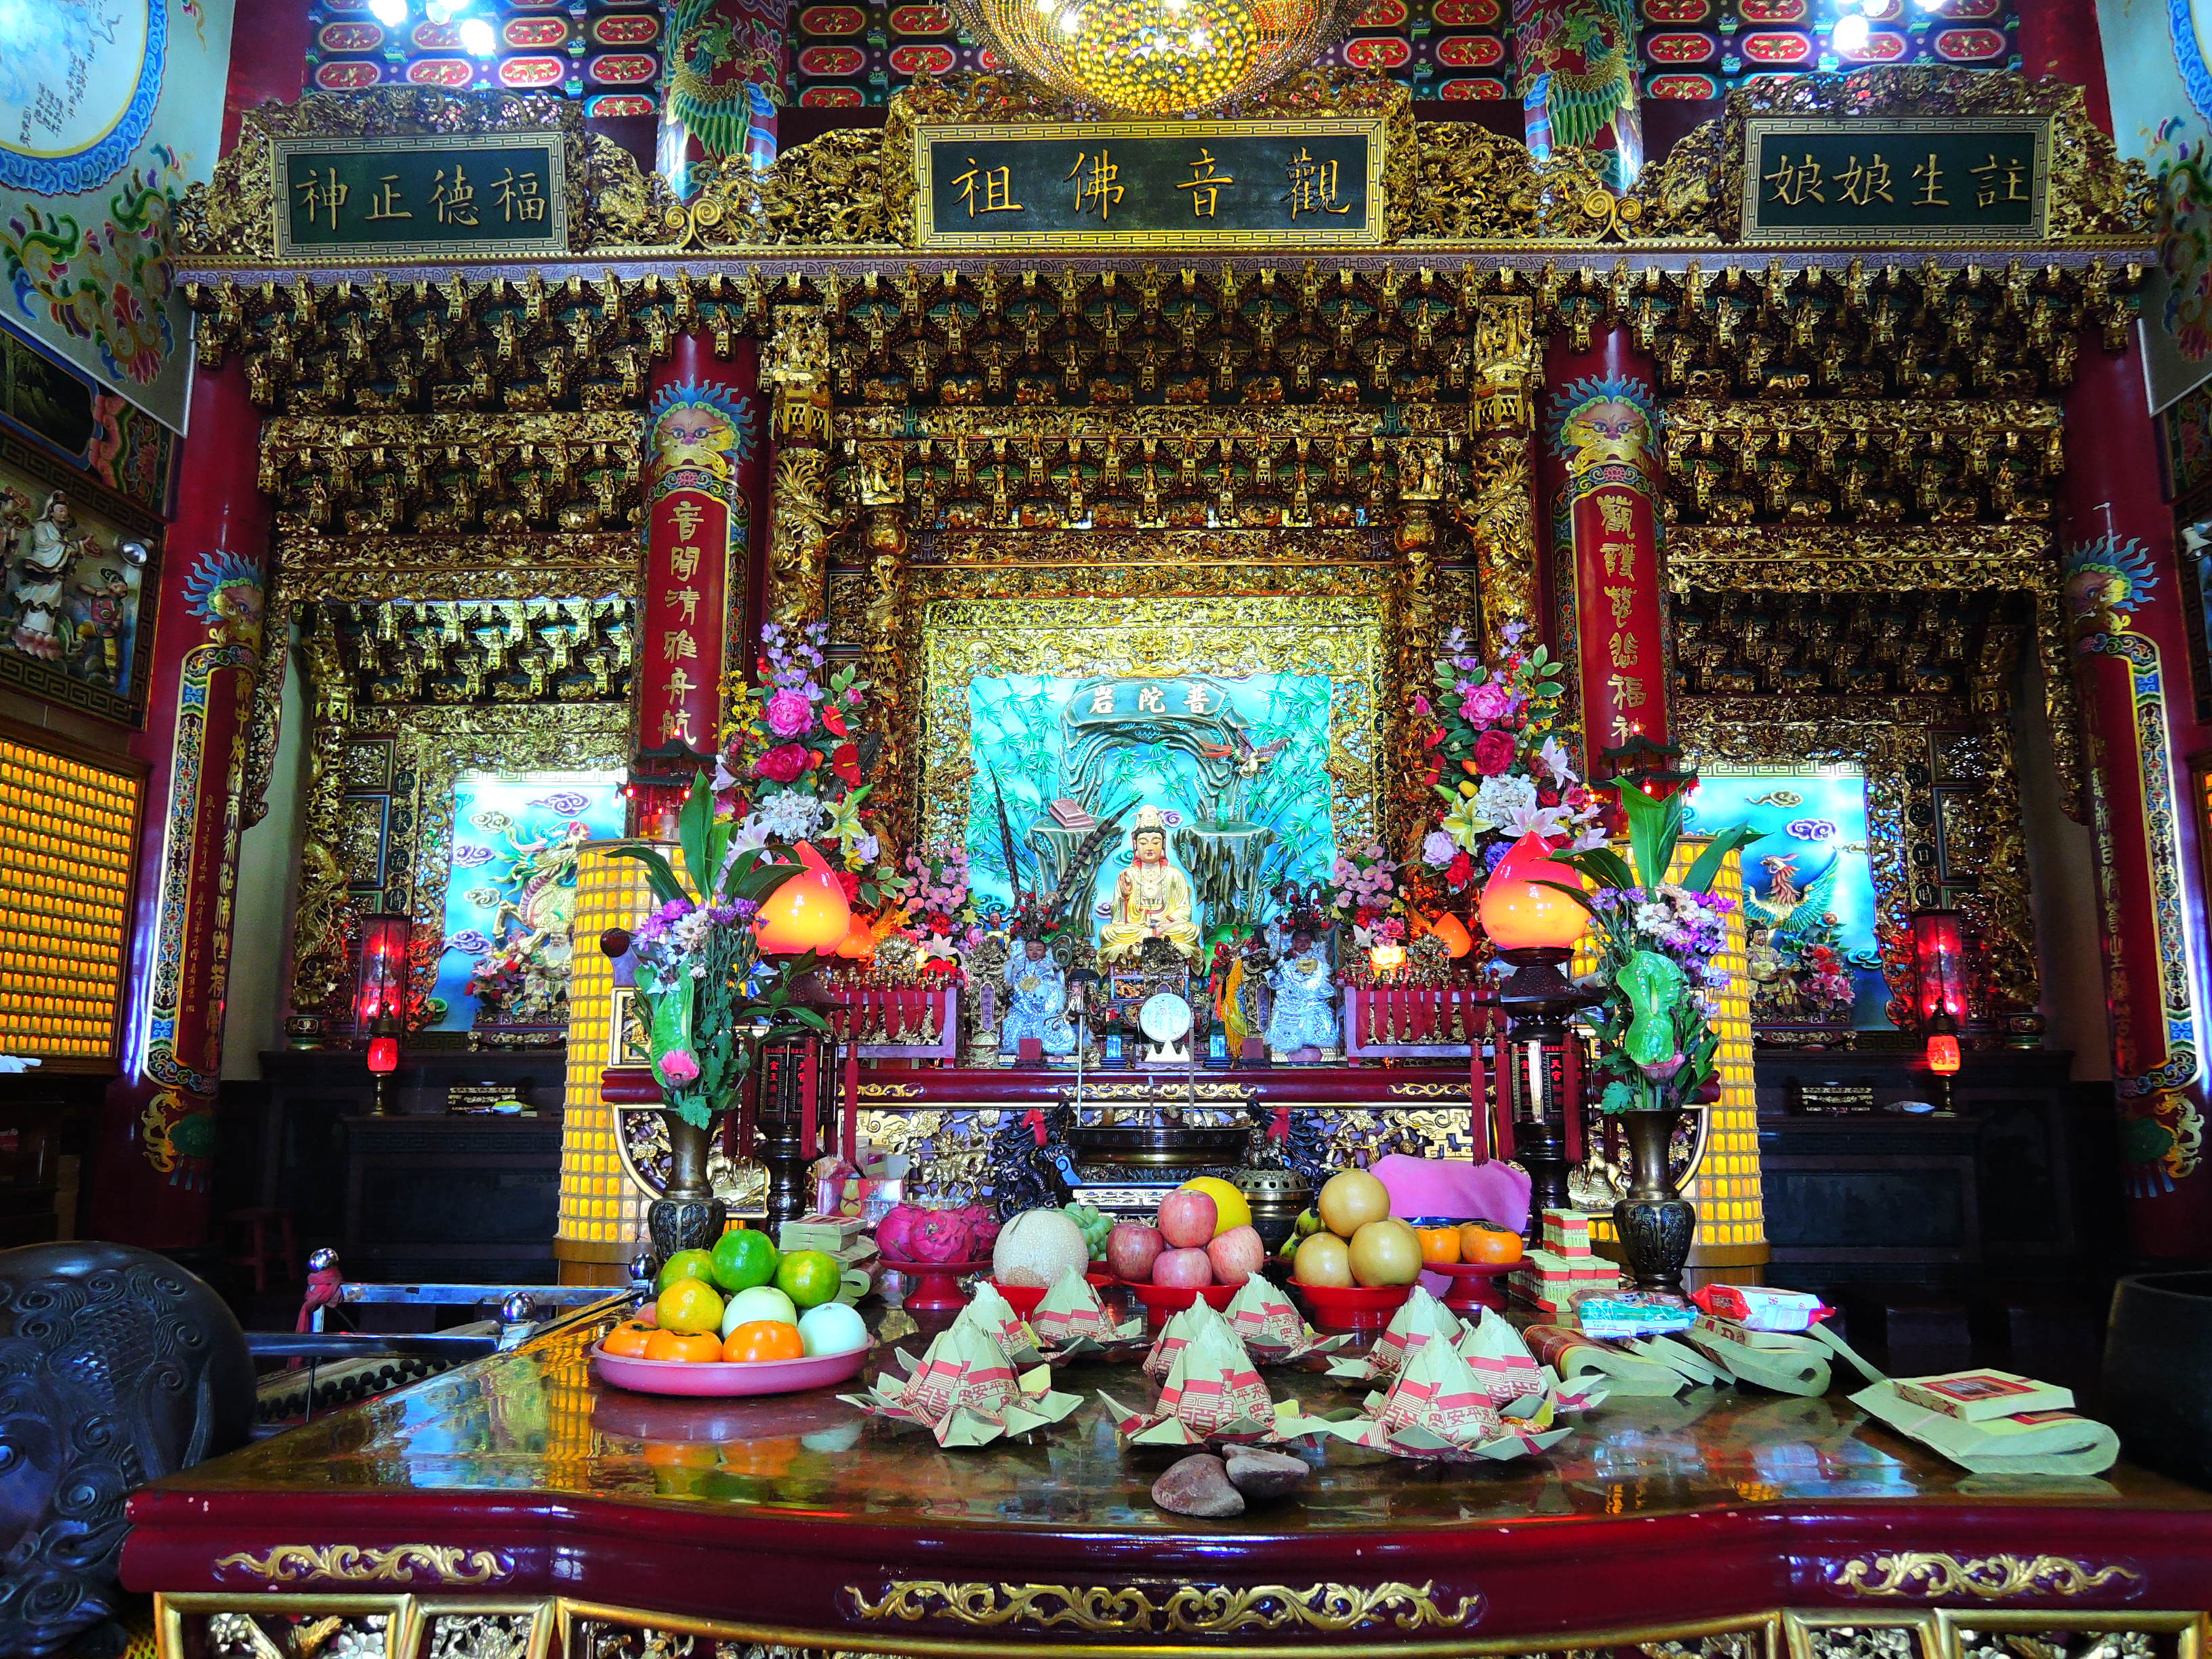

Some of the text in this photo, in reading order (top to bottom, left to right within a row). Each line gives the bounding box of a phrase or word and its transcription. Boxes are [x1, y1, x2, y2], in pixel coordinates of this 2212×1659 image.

[295, 163, 546, 230] 福德正神
[950, 146, 1353, 222] 觀音佛祖
[1763, 153, 2030, 209] 註生娘娘
[1088, 684, 1211, 714] 普陀岩
